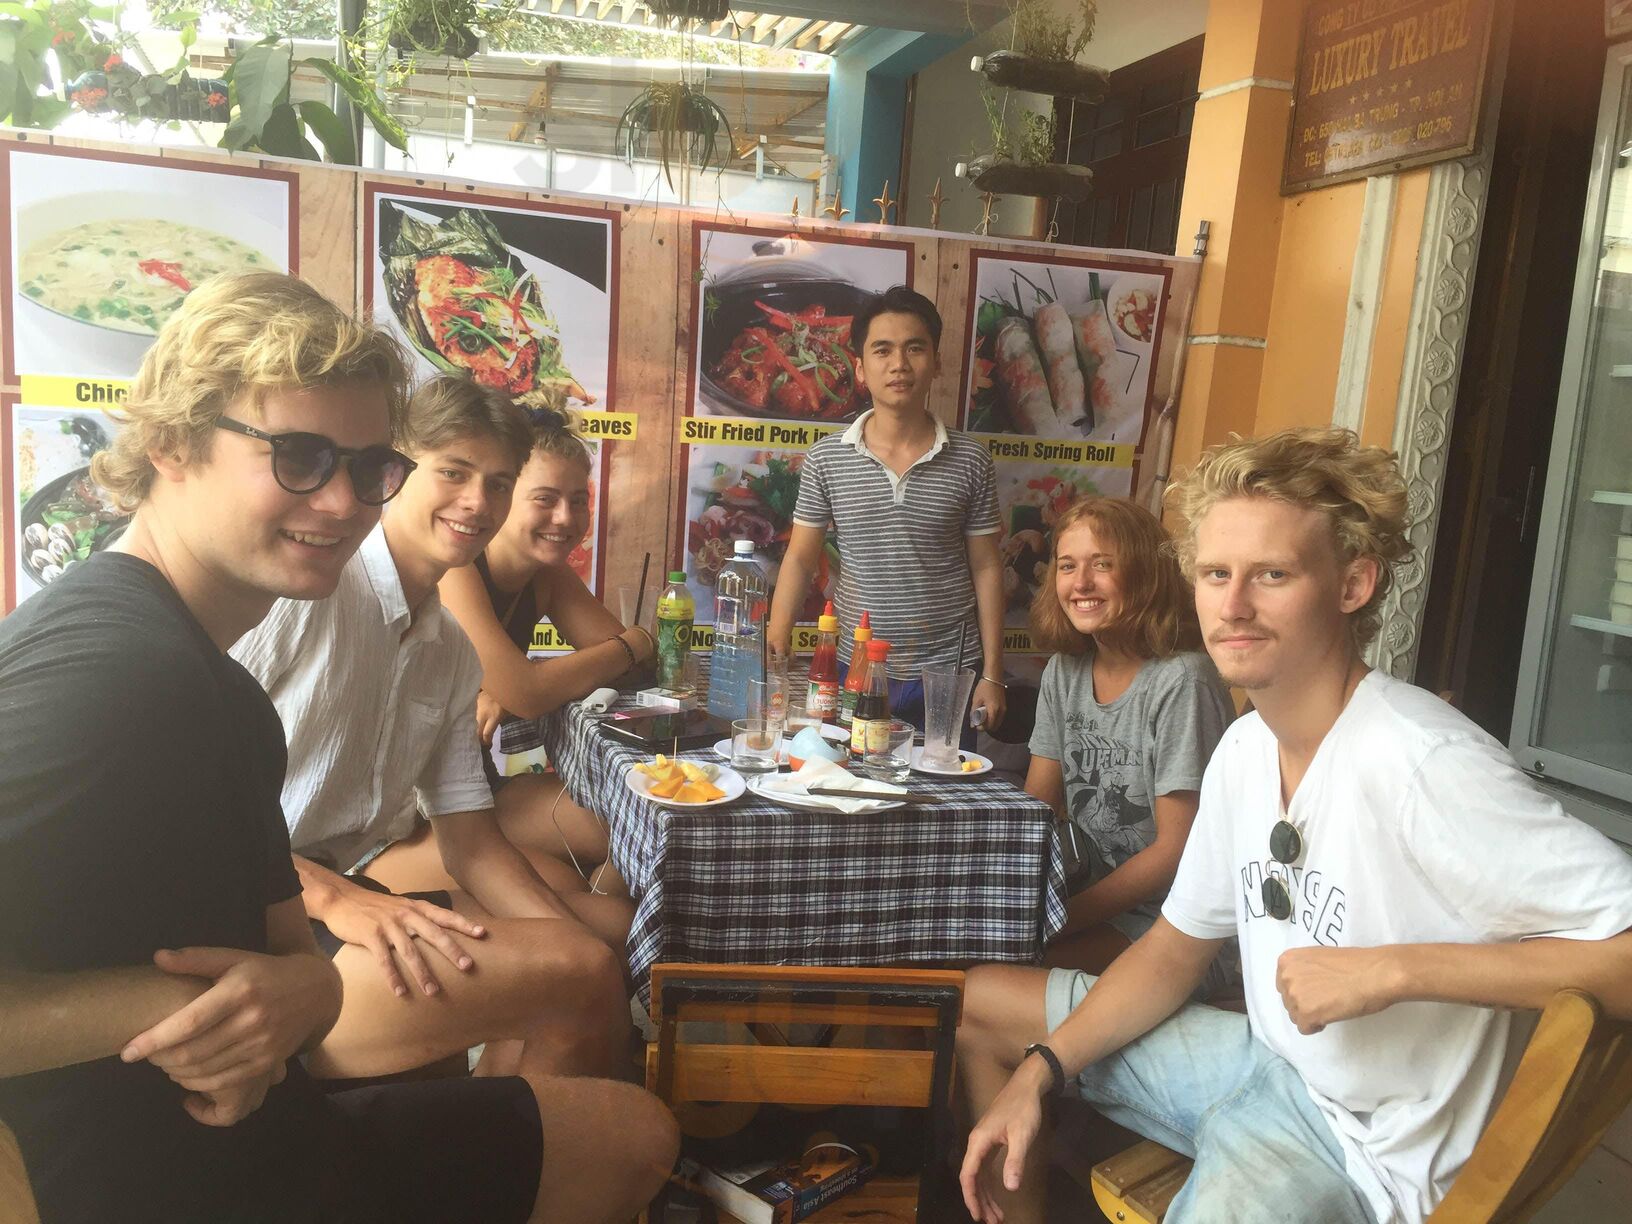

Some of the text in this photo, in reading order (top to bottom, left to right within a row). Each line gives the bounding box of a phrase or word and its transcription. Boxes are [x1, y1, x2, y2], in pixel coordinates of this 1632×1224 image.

[1309, 0, 1471, 96] LUXURY TRAVEL
[75, 382, 128, 403] Chic
[578, 418, 632, 436] eaves
[685, 420, 717, 439] Stir
[721, 423, 765, 442] Fried
[769, 426, 809, 445] Pork
[988, 440, 1116, 462] Fresh Spring Roll
[691, 630, 714, 647] No
[798, 631, 819, 648] Se
[1003, 633, 1031, 648] with
[821, 1174, 858, 1203] Southeast
[803, 1195, 820, 1210] Asia
